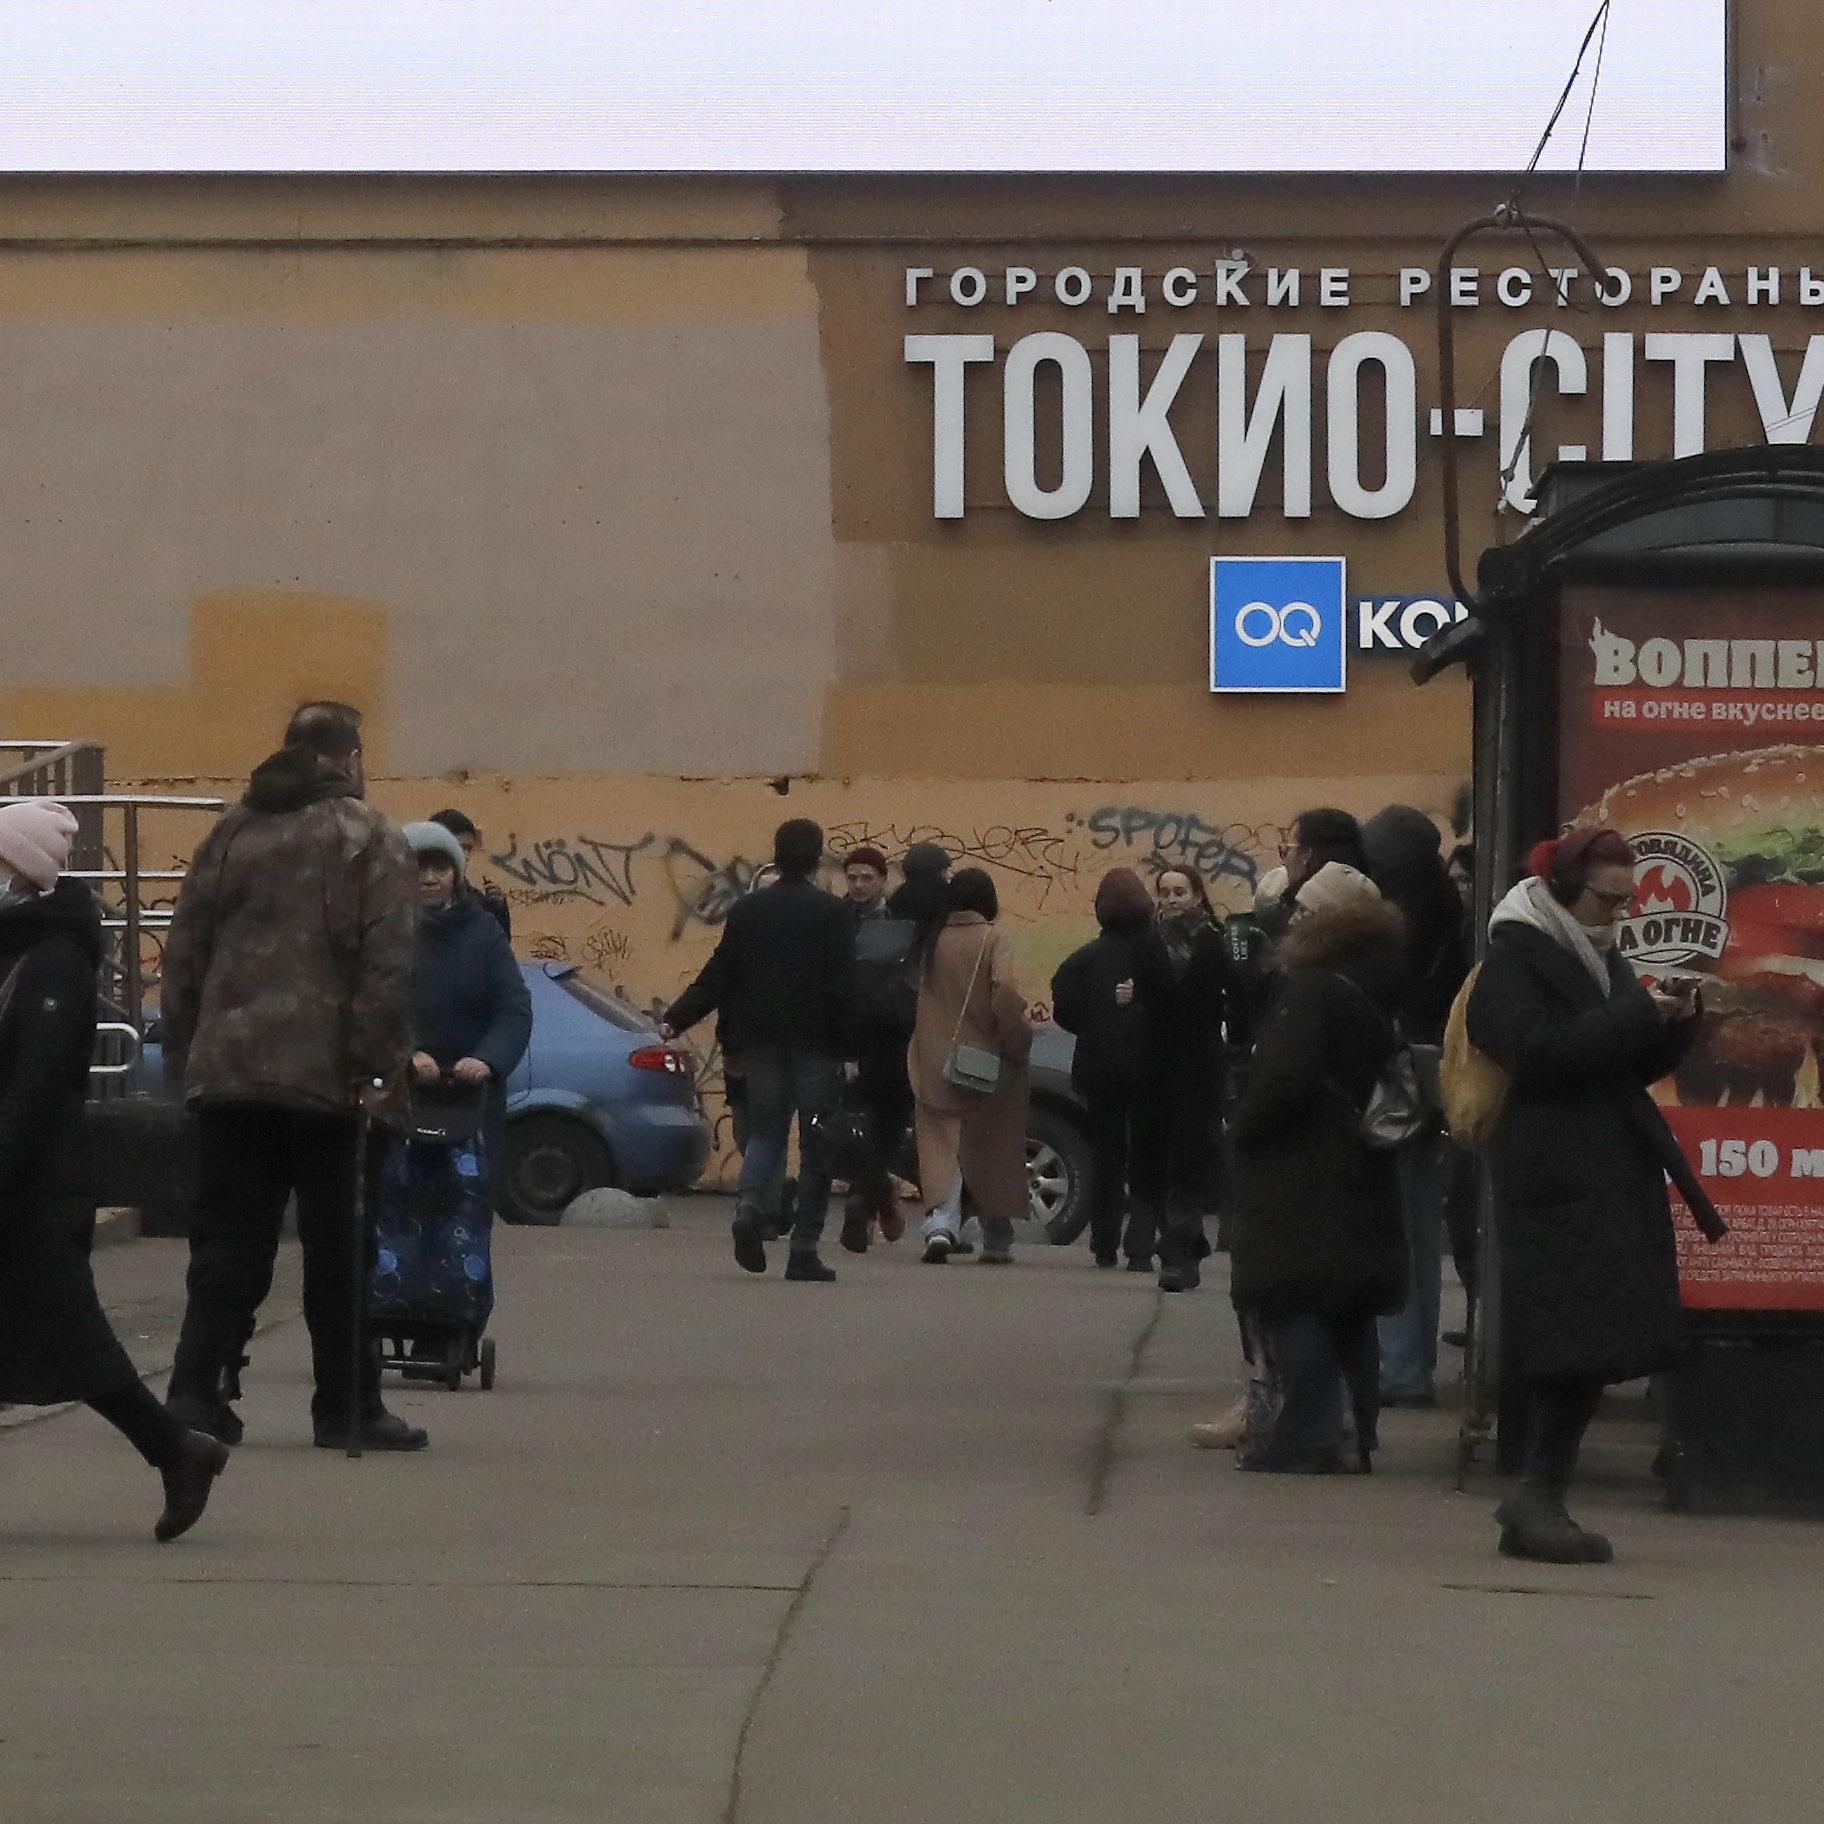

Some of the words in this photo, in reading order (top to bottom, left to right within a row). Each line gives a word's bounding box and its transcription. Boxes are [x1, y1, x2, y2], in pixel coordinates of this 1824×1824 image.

[904, 262, 1350, 314] ГОРОДСКИЕ
[1359, 600, 1470, 649] КО
[1603, 699, 1637, 719] на
[1642, 700, 1707, 721] огне
[1633, 838, 1717, 898] ОВЯДИНА
[1642, 917, 1721, 950] ОГНЕ
[1699, 1138, 1779, 1179] 150
